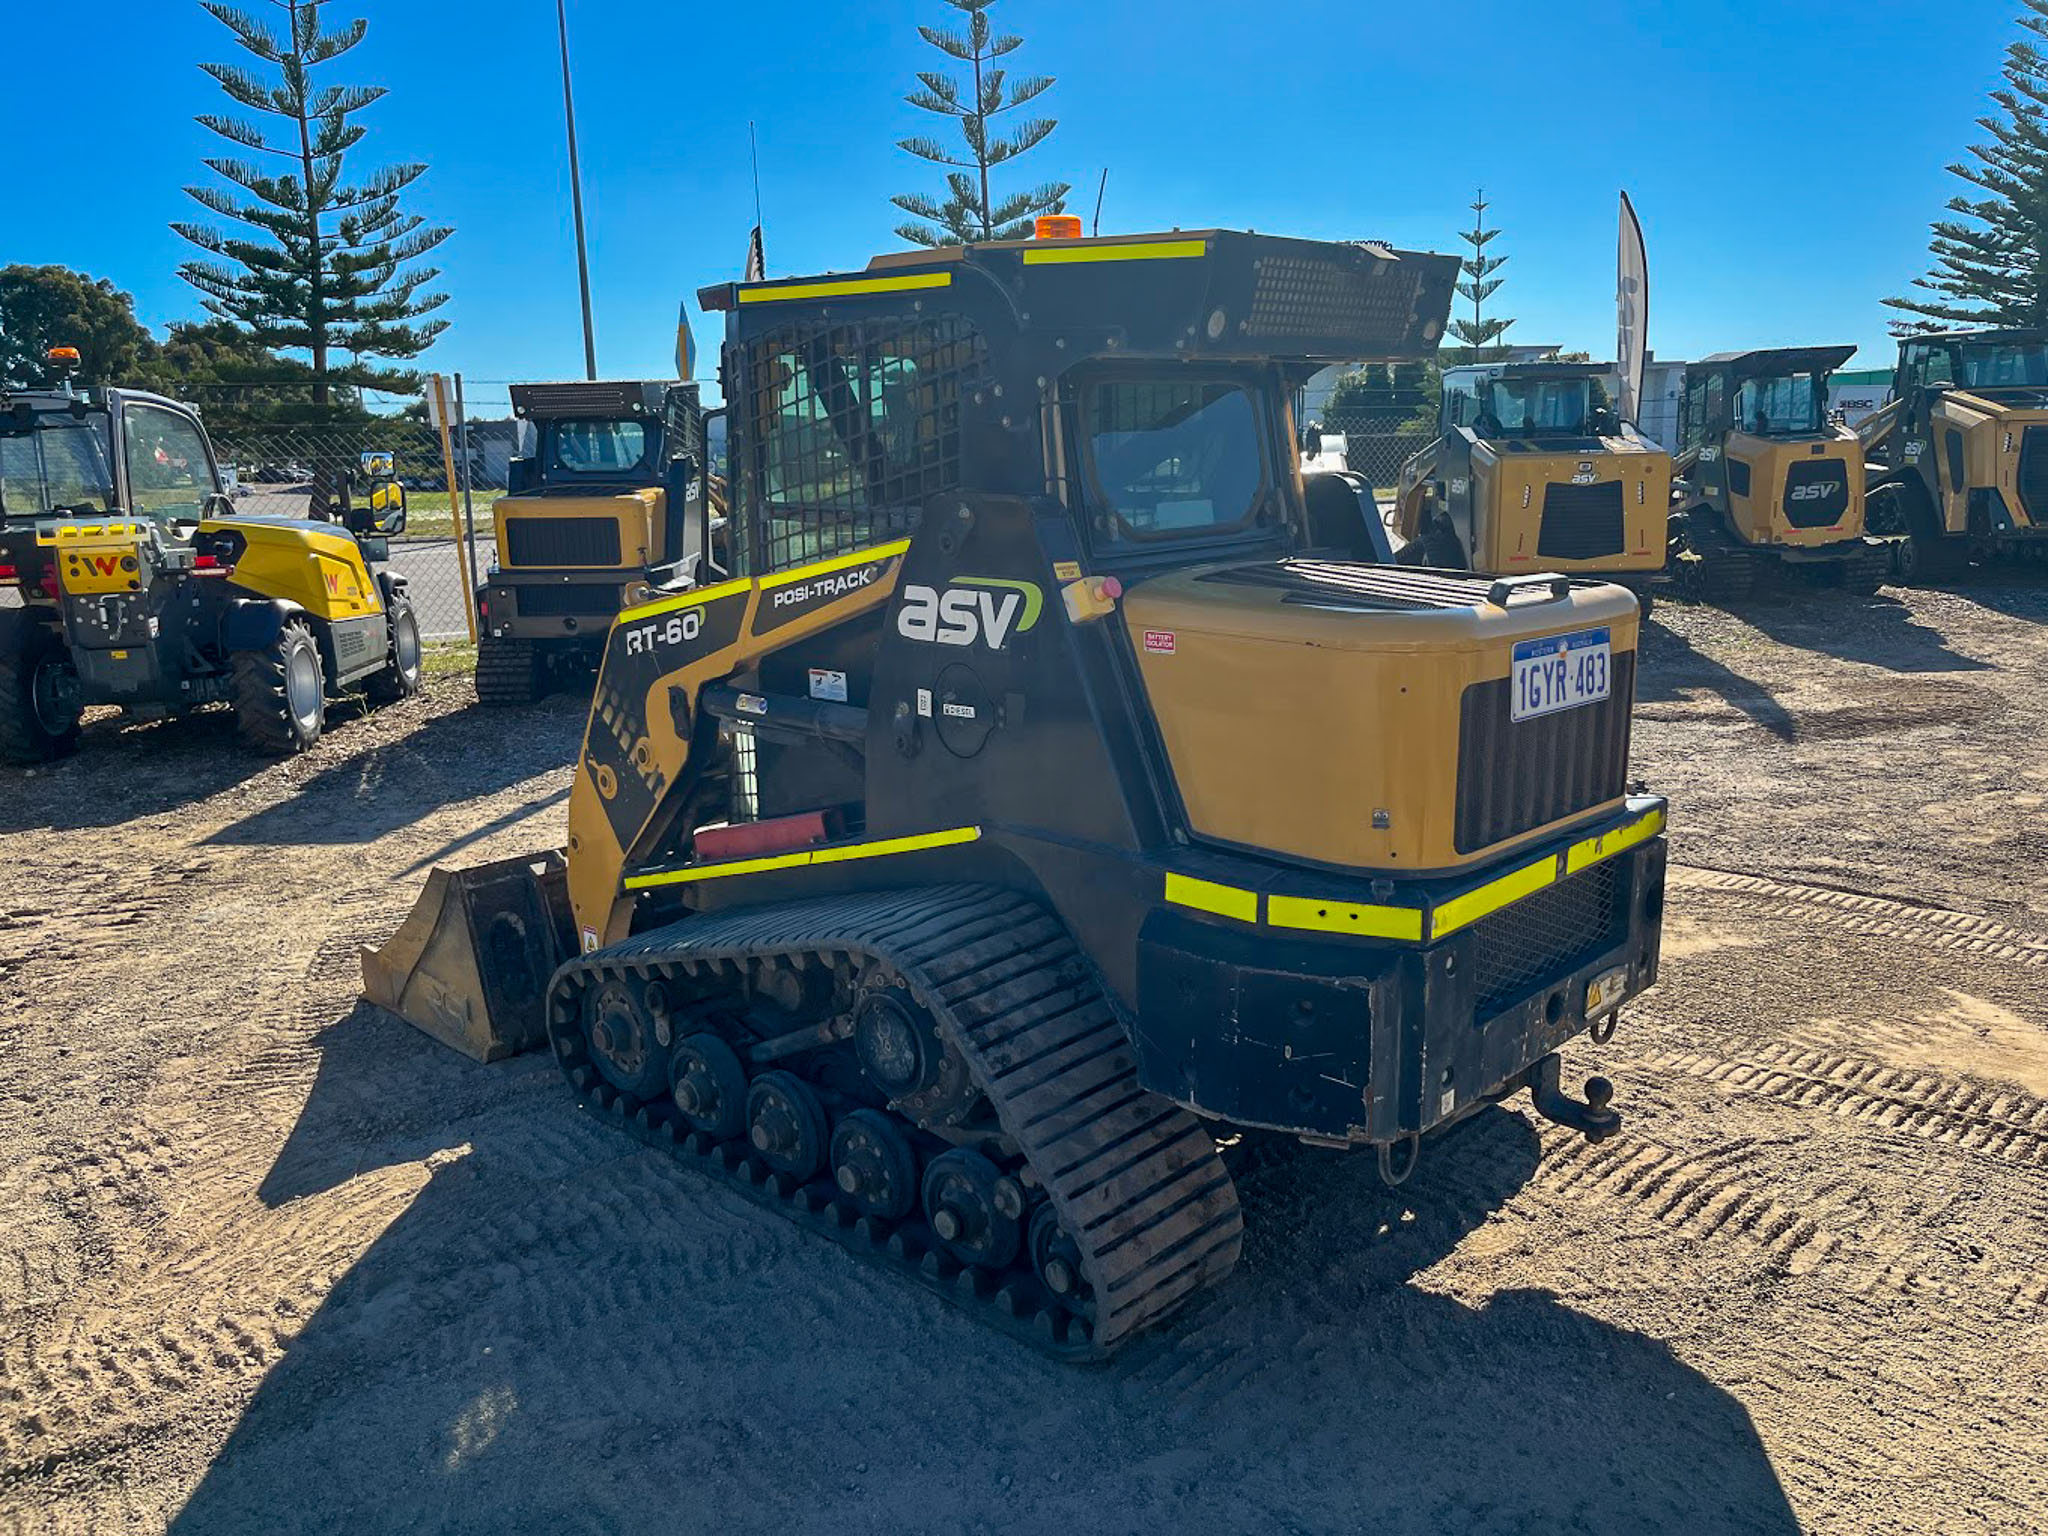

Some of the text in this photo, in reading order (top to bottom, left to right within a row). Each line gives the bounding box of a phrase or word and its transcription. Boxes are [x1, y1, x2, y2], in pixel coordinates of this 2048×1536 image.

[1571, 474, 1596, 484] asv
[1791, 484, 1834, 500] asv
[774, 568, 871, 609] POSI-TRACK
[626, 613, 699, 656] RT-60
[898, 584, 1020, 650] asv
